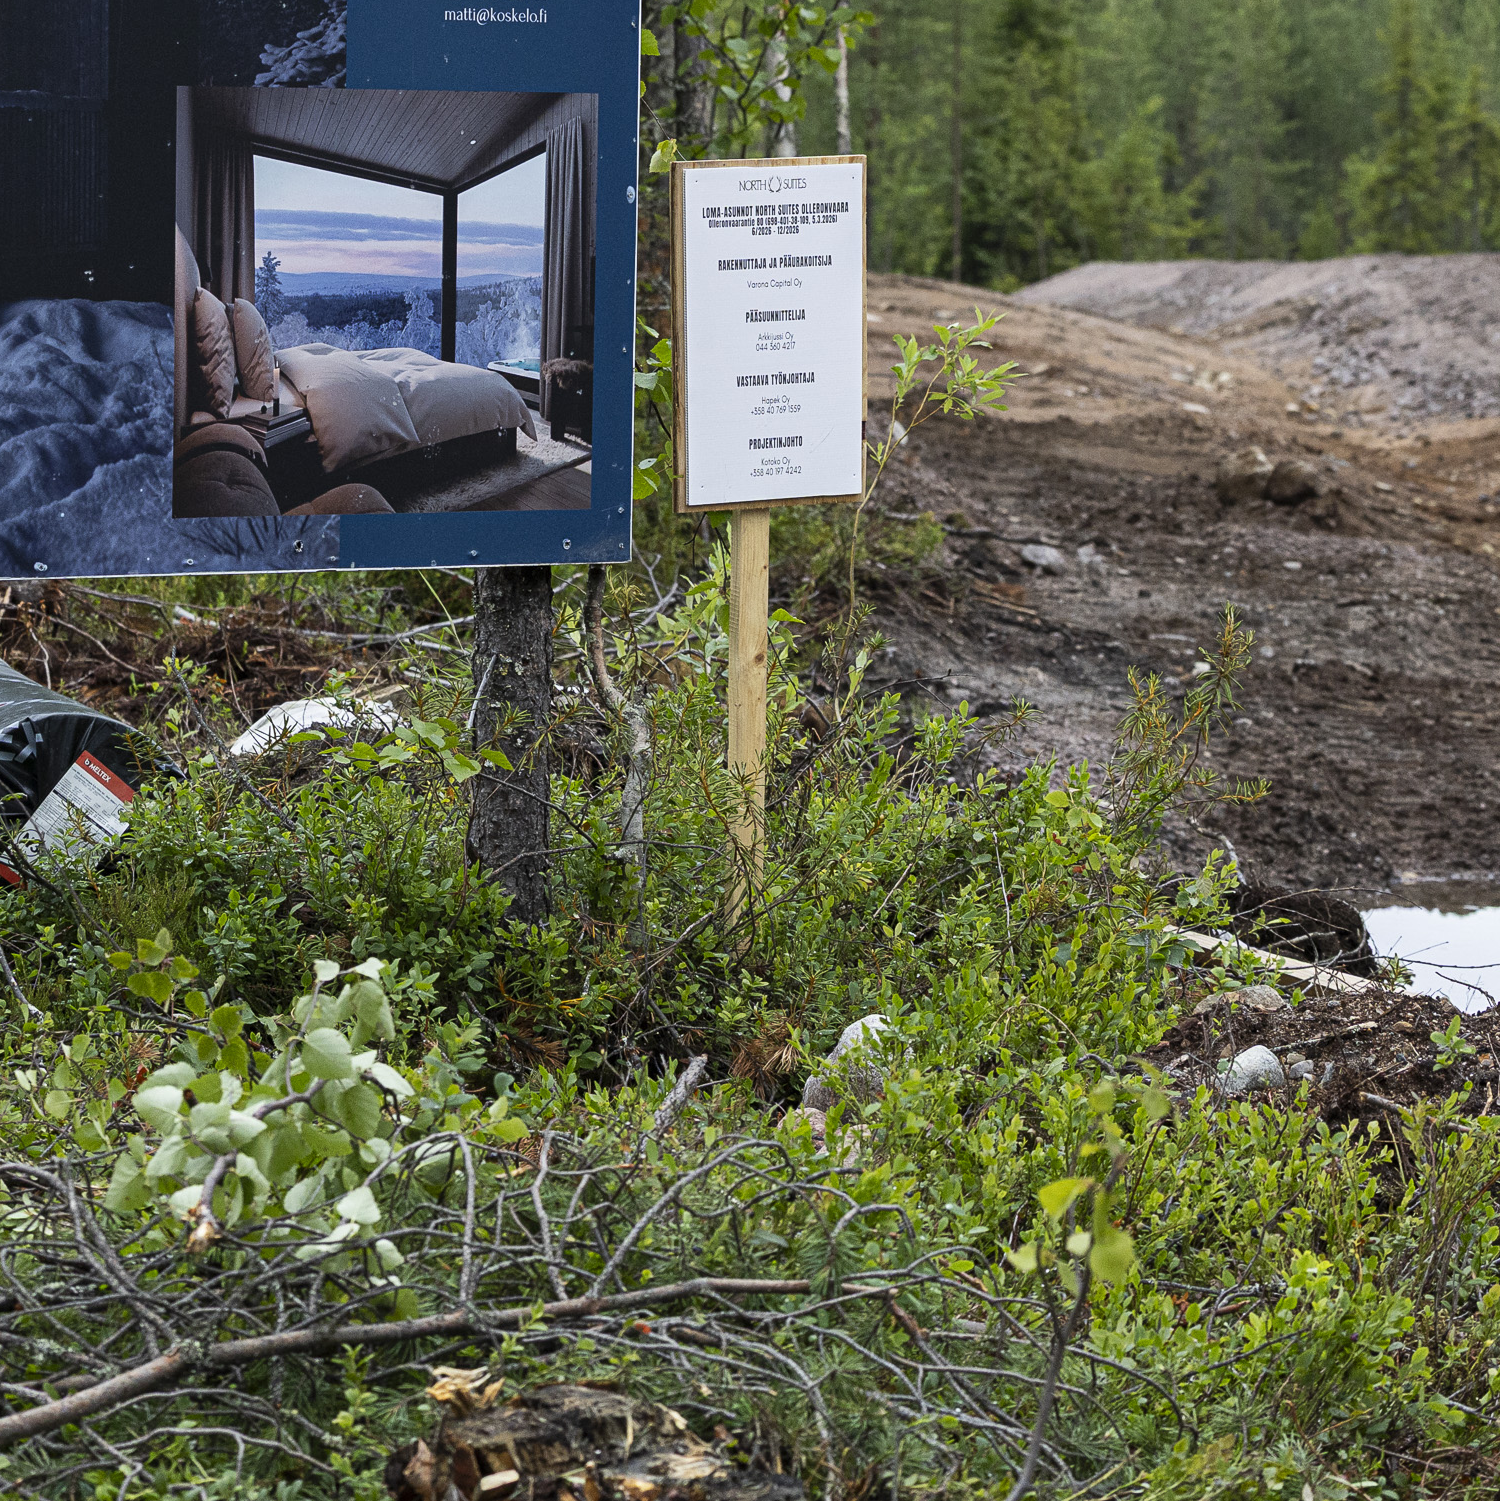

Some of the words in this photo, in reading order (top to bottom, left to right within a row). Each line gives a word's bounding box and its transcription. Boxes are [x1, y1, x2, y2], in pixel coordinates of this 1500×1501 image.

[444, 7, 547, 26] matti@koskelo.fi
[738, 179, 767, 191] NORTH
[783, 178, 807, 189] SUITES
[702, 206, 753, 218] LOMA-ASUNNOT
[755, 205, 776, 216] NORTH
[778, 204, 799, 215] SUITES
[802, 202, 849, 214] OLLERONVAARA
[718, 259, 767, 271] RAKENNUTTAJA
[769, 258, 777, 269] JA
[780, 255, 832, 268] PÄÄURAKOITSIJA
[770, 278, 792, 289] Capital
[794, 279, 803, 288] Oy
[746, 309, 806, 323] PÄÄSUUNNITTELIJA
[785, 332, 794, 341] Oy
[737, 375, 769, 387] VASTAAVA
[771, 372, 815, 385] TYÖNJOHTAJA
[782, 395, 790, 405] Oy
[749, 436, 803, 450] PROJEKTINJOHTO
[782, 457, 791, 466] Oy
[89, 763, 112, 783] MELTEX
